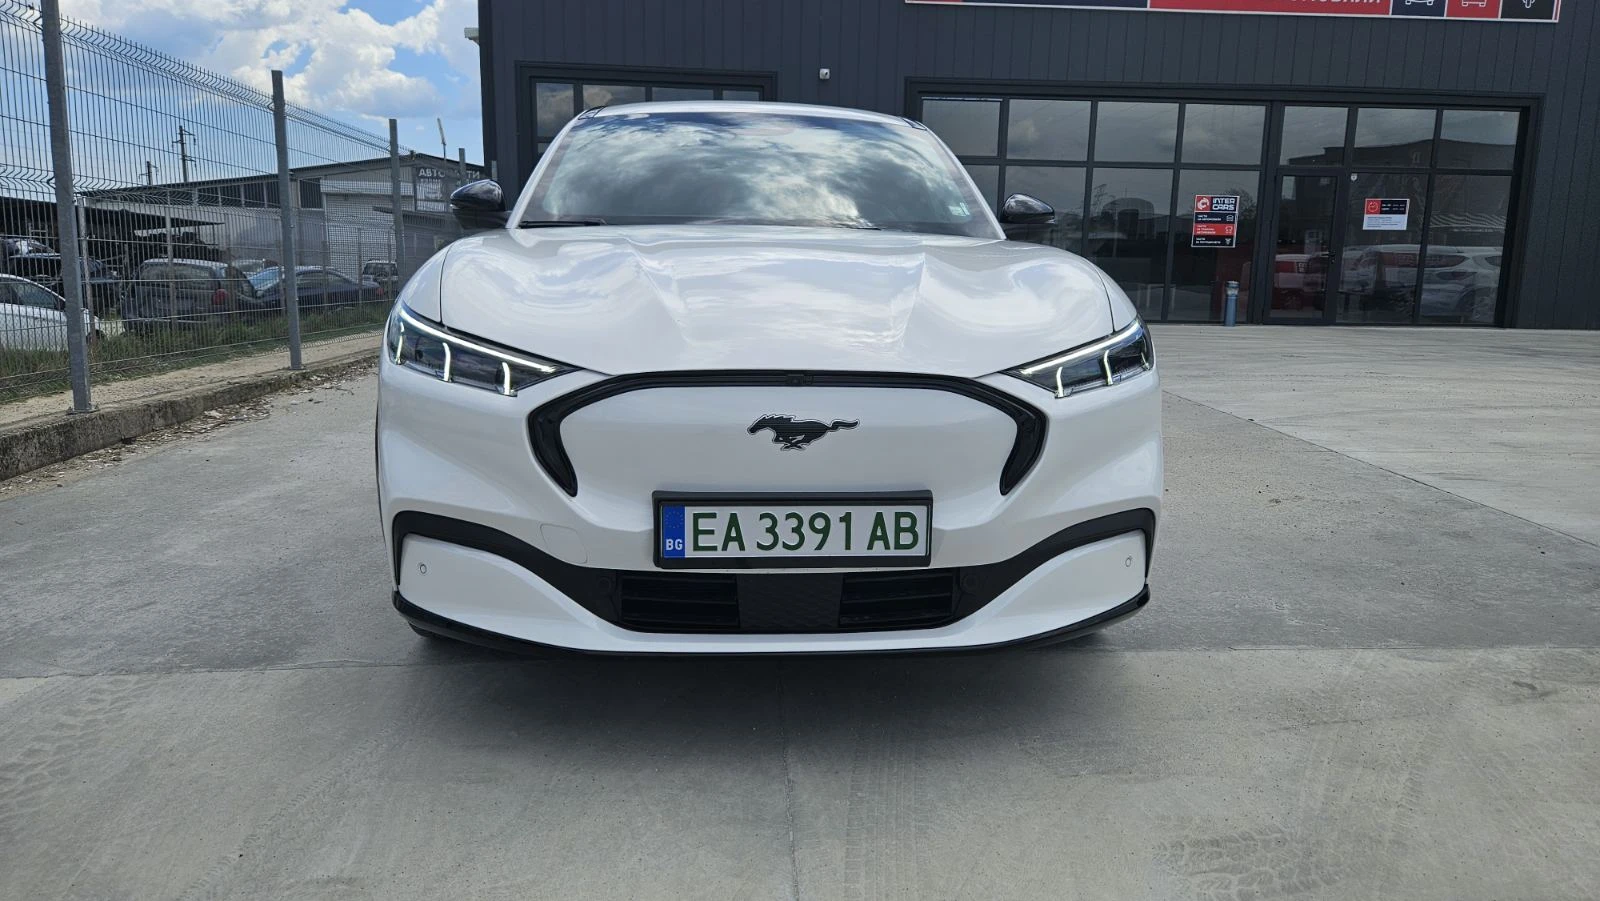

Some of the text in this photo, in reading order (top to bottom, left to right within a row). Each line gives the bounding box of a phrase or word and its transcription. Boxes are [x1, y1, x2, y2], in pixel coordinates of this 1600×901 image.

[665, 538, 683, 551] BG
[692, 511, 919, 552] EA 3391 AB
